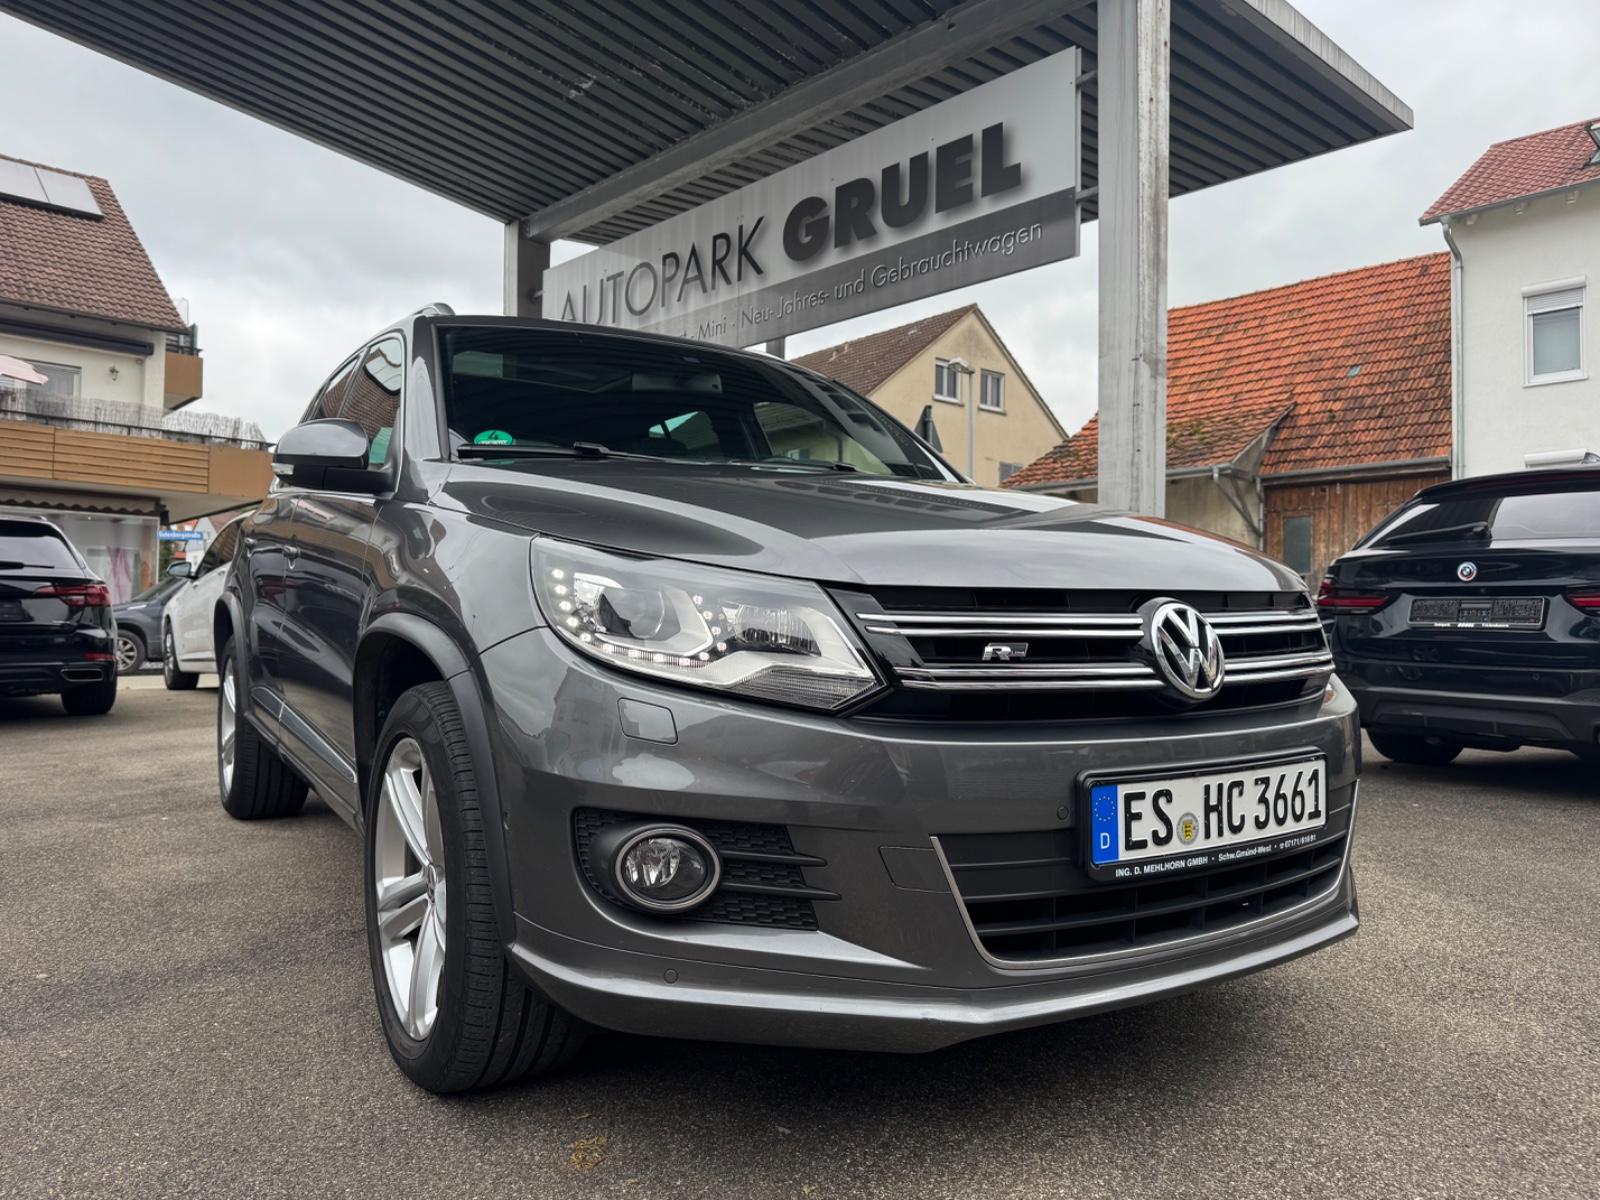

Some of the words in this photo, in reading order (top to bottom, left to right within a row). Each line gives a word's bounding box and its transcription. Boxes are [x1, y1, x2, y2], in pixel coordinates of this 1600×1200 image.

[561, 216, 764, 324] AUTOPARK
[783, 122, 1021, 261] GRUEL
[697, 316, 727, 341] Mini
[834, 268, 865, 300] und
[871, 223, 1043, 287] Gebrauchtwagen
[1100, 832, 1110, 849] D
[1123, 788, 1174, 851] ES
[1203, 779, 1246, 839] HC
[1254, 768, 1322, 830] 3661
[1115, 868, 1133, 878] ING.
[1134, 866, 1142, 875] D.
[1144, 858, 1185, 874] MEHLHORN
[1187, 856, 1208, 867] GMBH
